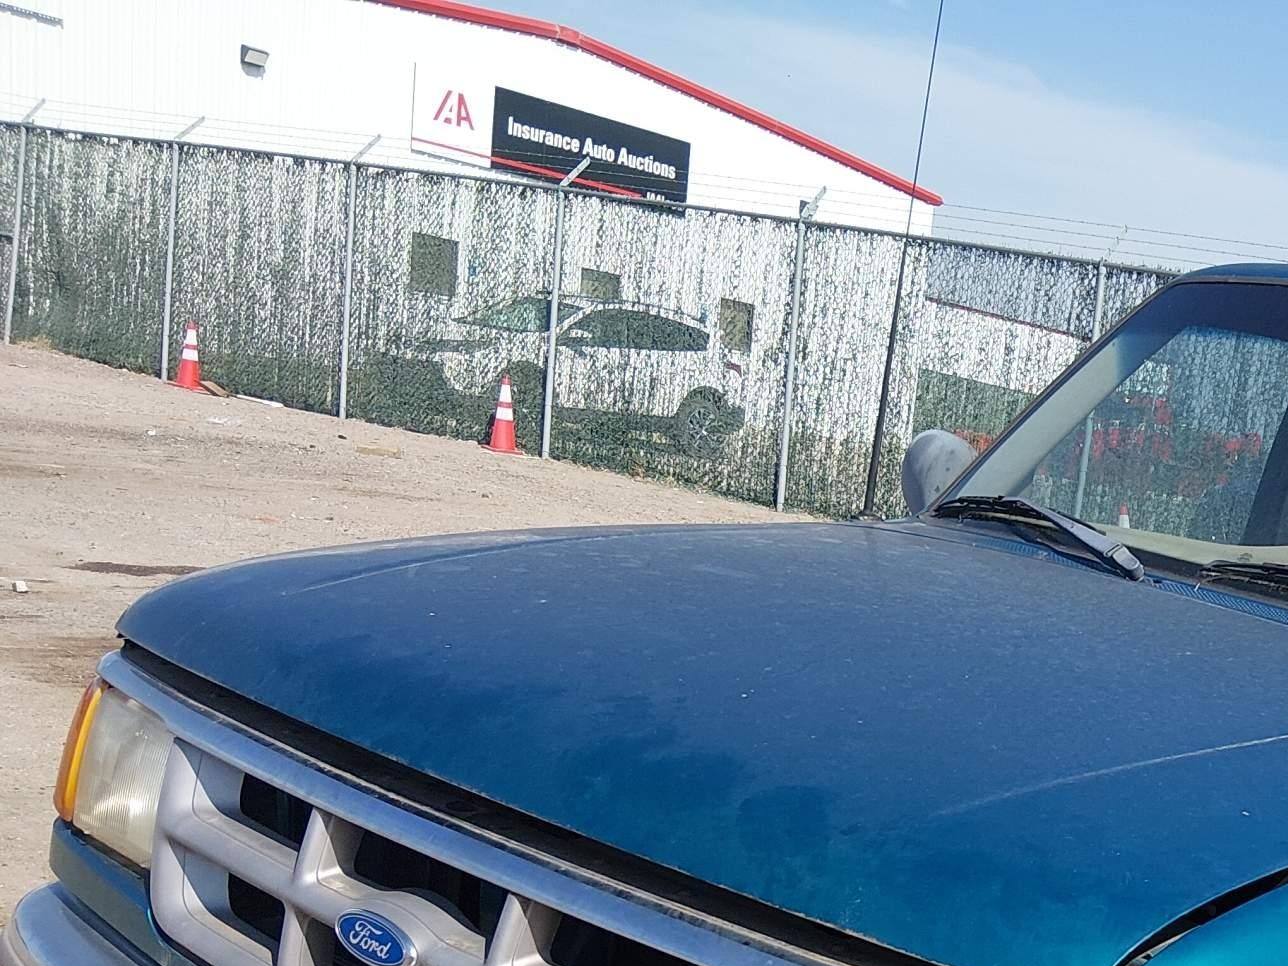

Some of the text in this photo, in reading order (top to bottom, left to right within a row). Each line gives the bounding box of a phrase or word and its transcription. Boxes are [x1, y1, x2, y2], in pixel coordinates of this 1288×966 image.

[507, 116, 677, 180] Insurance Auto Auctions
[350, 920, 391, 958] Ford
